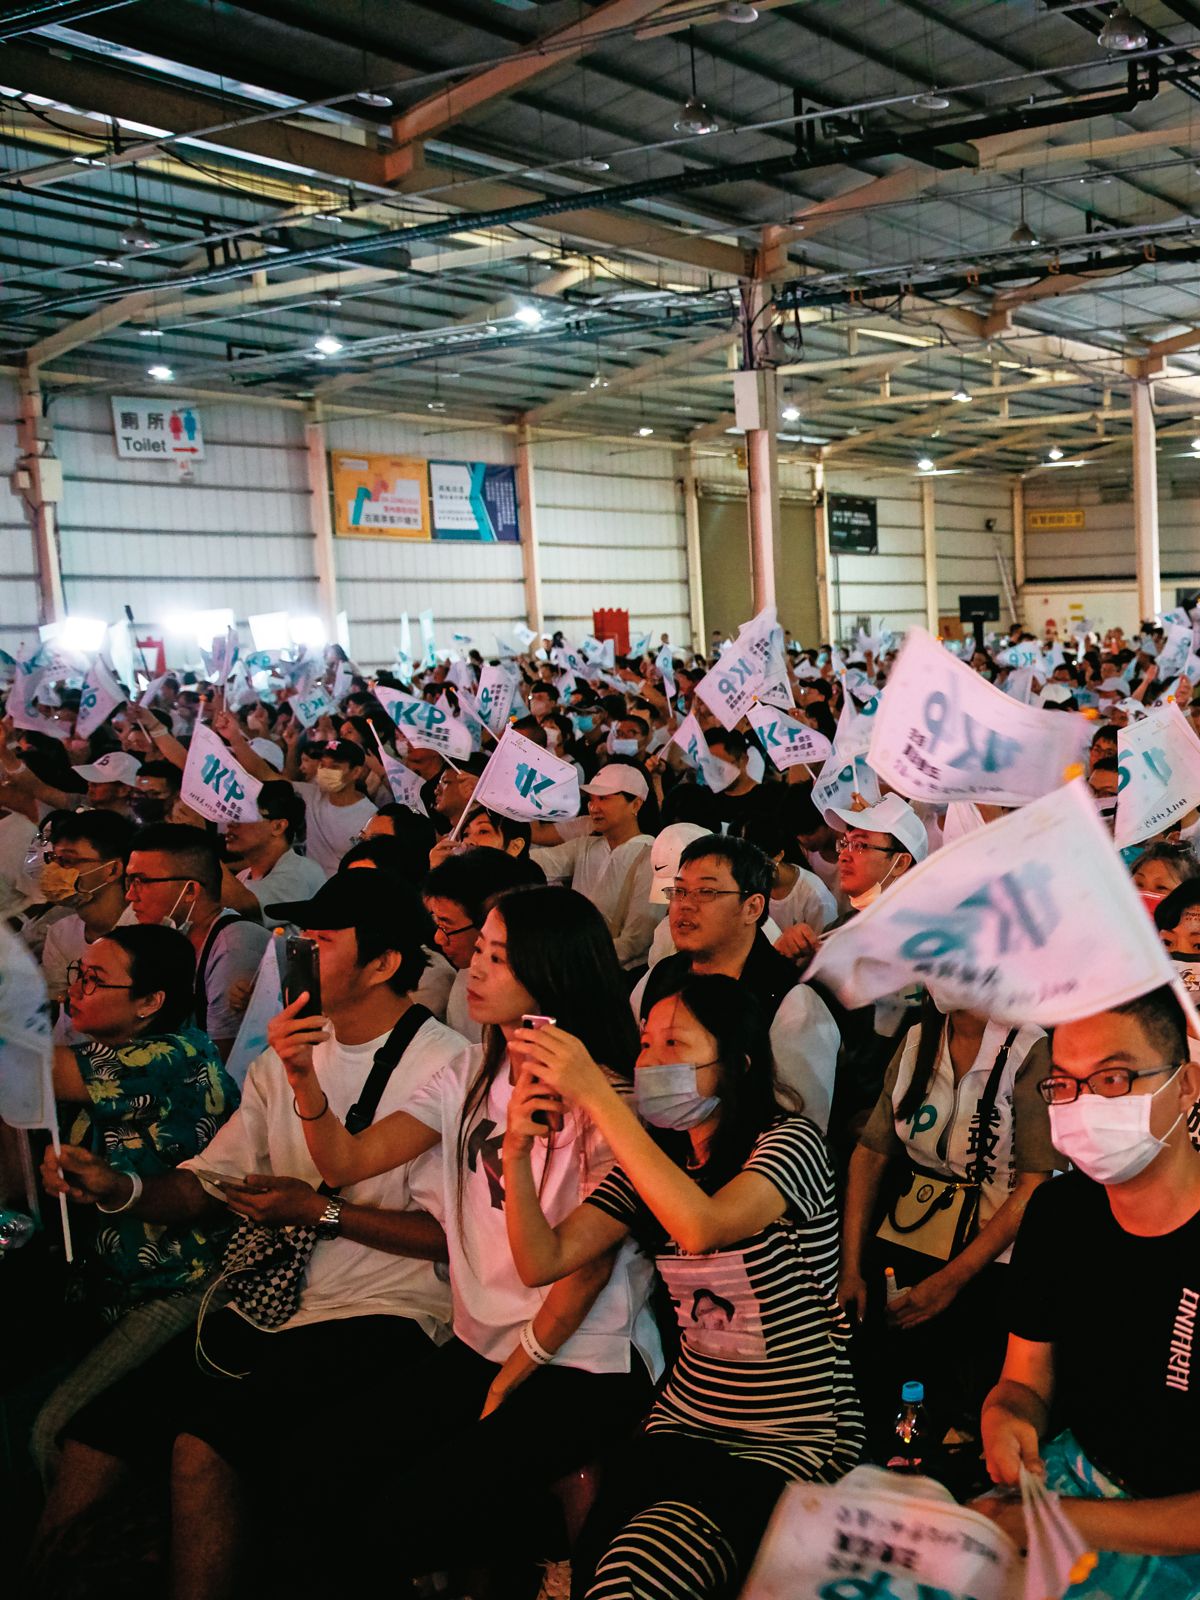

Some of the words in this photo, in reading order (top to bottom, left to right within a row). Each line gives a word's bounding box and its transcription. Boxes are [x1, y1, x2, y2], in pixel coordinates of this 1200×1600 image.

[122, 437, 166, 452] Toilet
[388, 700, 447, 730] KP
[200, 753, 246, 802] KP
